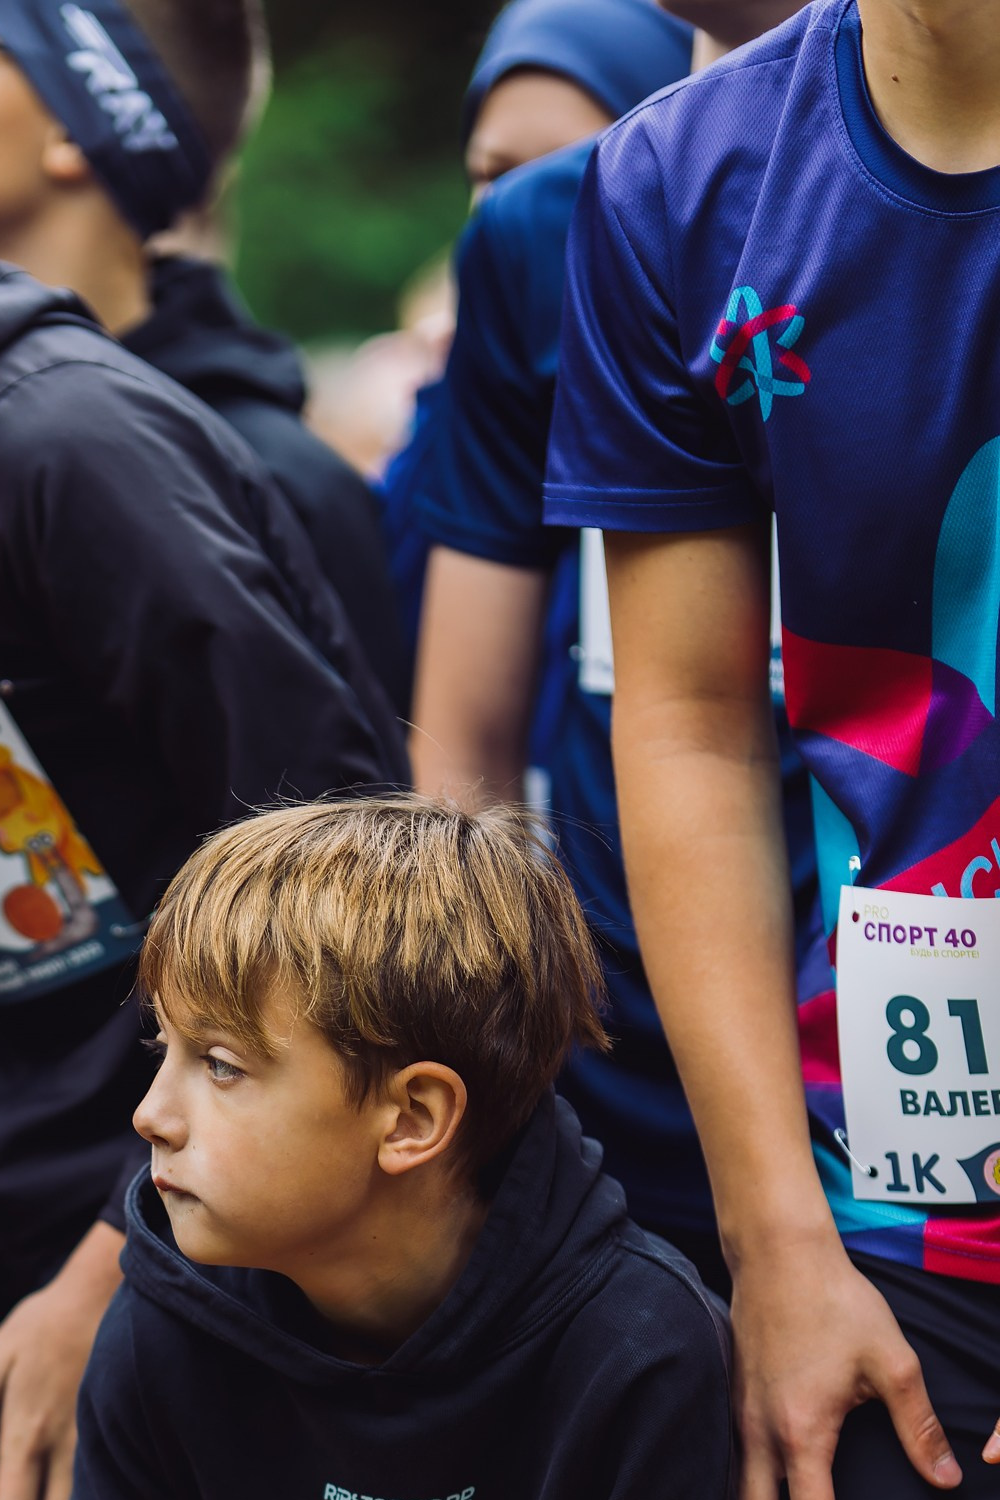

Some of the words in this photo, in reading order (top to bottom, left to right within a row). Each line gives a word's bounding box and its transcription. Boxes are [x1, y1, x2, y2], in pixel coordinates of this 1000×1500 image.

[864, 904, 889, 919] PRO
[864, 922, 937, 946] СПОРТ
[944, 928, 977, 948] 40
[886, 995, 989, 1076] 81
